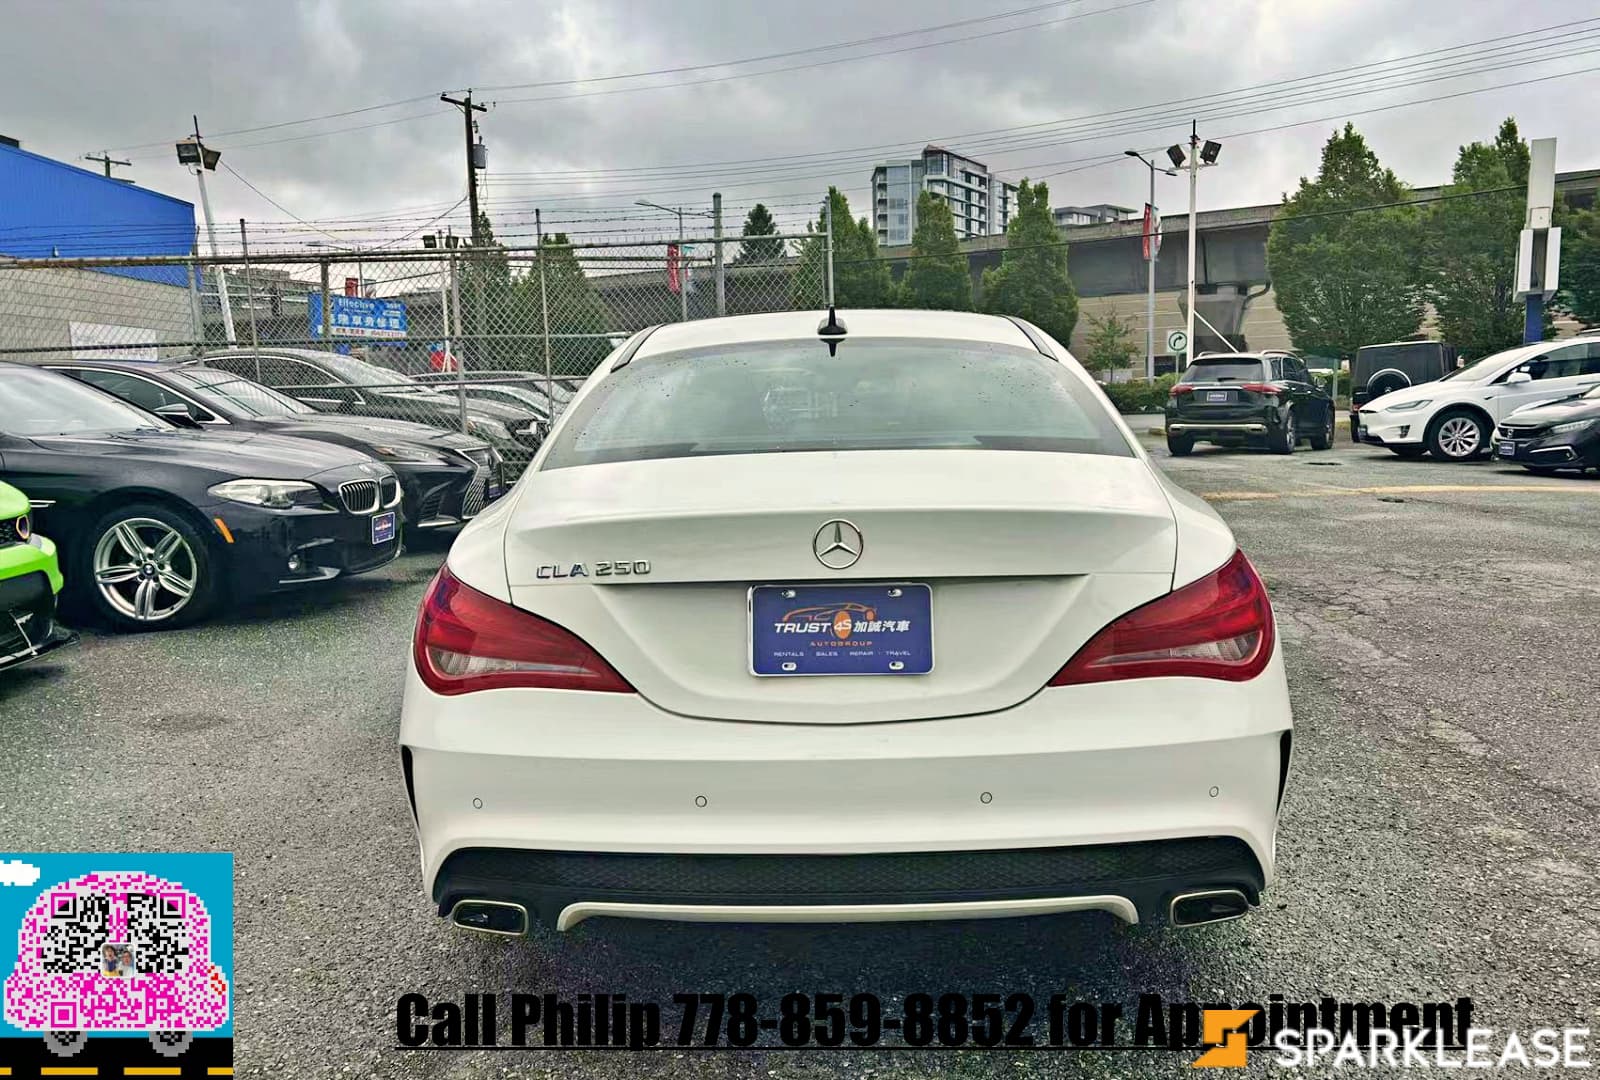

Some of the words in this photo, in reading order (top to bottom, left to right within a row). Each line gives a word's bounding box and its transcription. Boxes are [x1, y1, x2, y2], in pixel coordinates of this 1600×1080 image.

[536, 562, 589, 579] CLA
[595, 559, 652, 577] 250
[774, 622, 831, 633] TRUST
[853, 620, 911, 633] 加誠汽車
